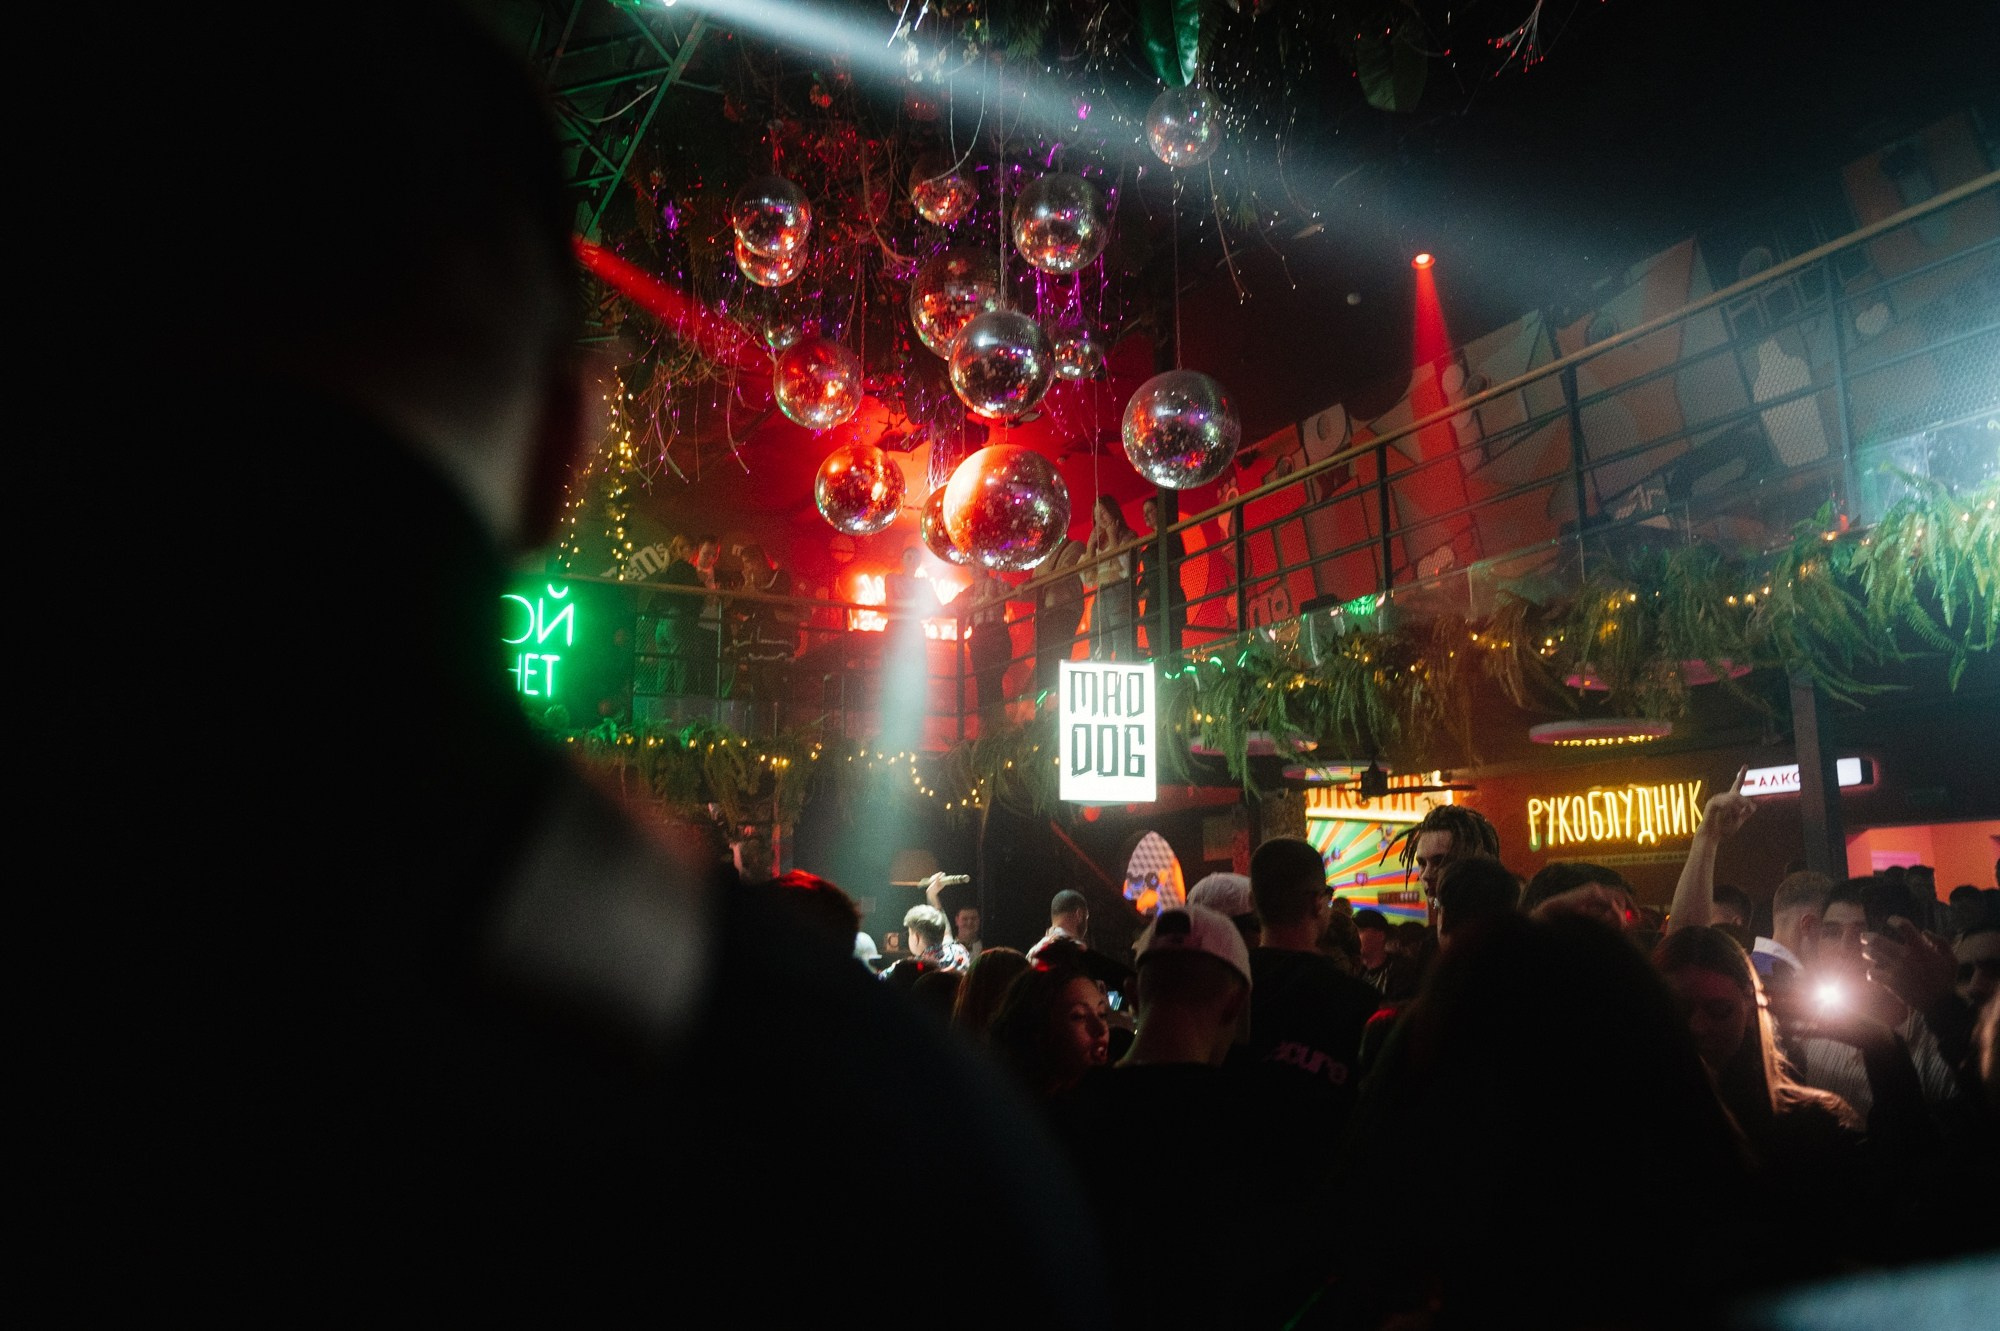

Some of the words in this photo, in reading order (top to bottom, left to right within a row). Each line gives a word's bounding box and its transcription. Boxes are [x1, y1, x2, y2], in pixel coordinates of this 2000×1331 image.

[1069, 670, 1144, 718] MAD
[1071, 723, 1146, 777] DOG
[1528, 780, 1703, 846] РУКОБЛУДНИК
